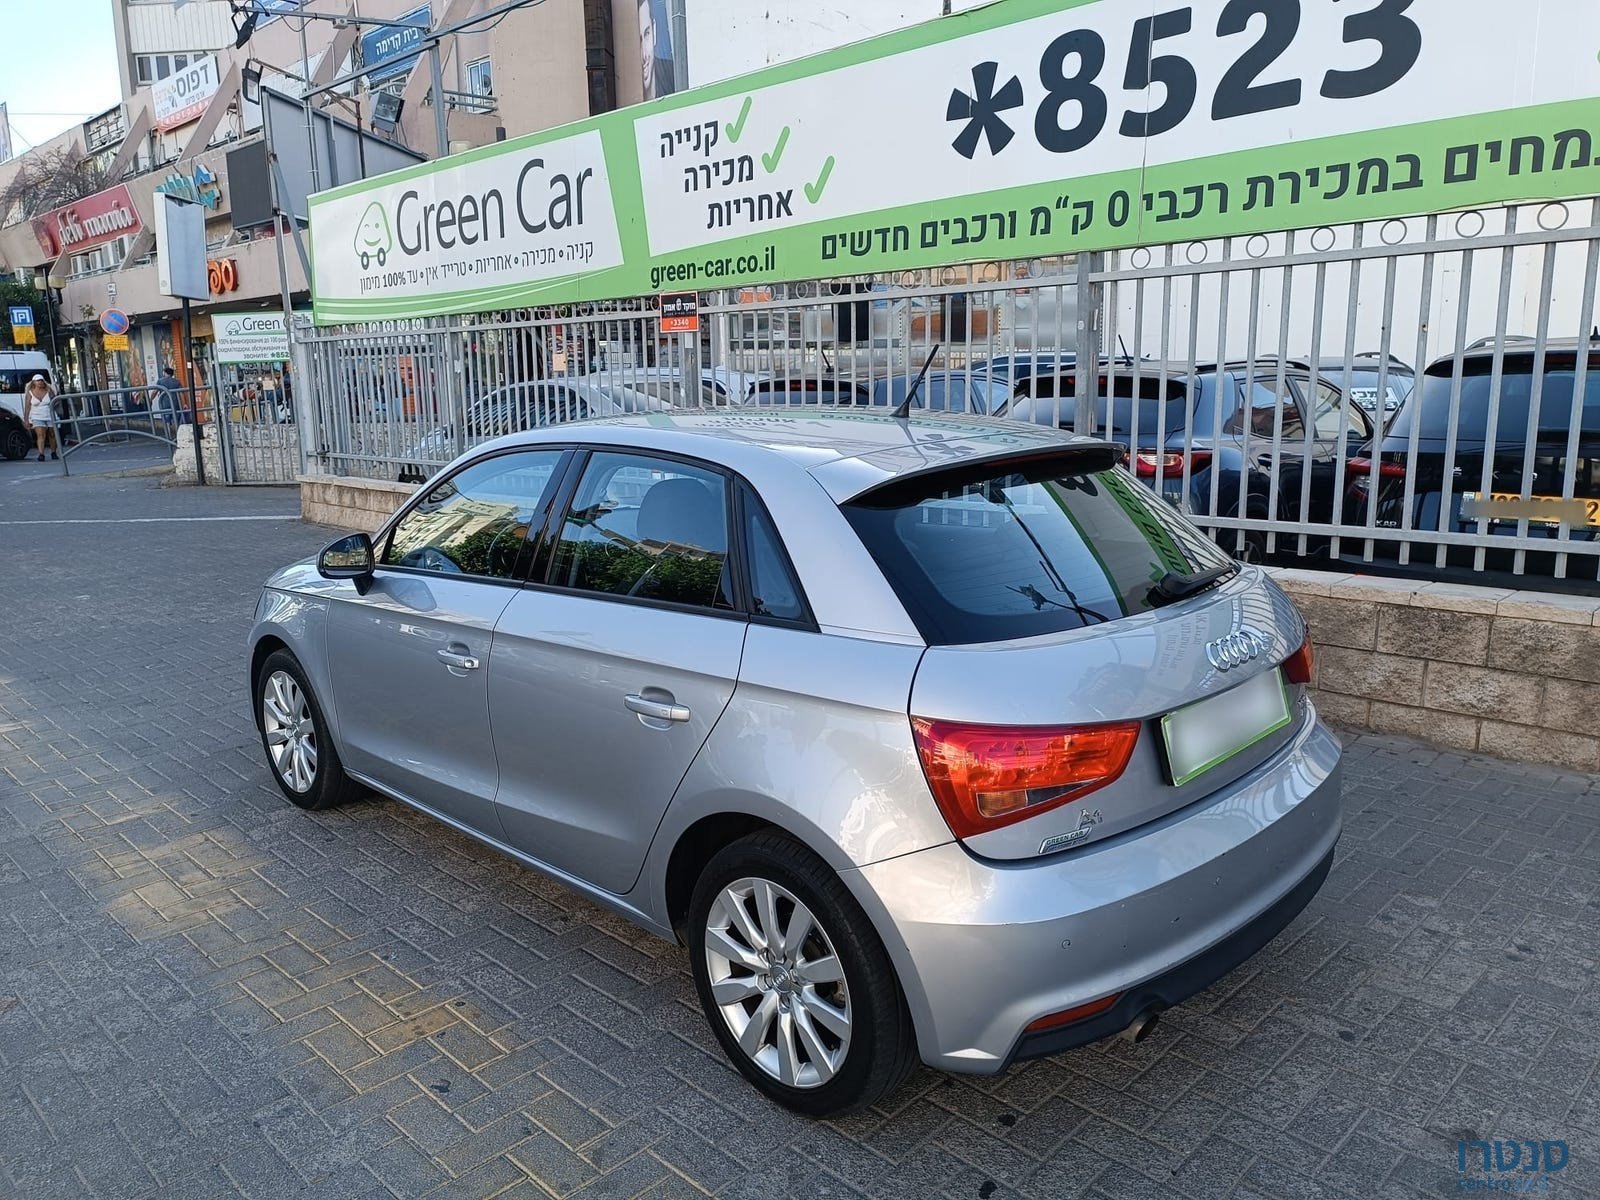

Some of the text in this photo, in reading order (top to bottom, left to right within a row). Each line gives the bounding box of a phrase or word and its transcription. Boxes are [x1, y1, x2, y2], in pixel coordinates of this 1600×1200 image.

[403, 28, 419, 43] בית
[176, 64, 208, 97] דפוס
[660, 120, 719, 158] קנייה
[1443, 128, 1600, 185] מחים
[684, 154, 754, 193] מכירה
[1242, 153, 1424, 211] במכירת
[396, 158, 593, 256] Green Car
[707, 189, 794, 229] אחריות
[1107, 189, 1130, 228] 0
[1142, 181, 1229, 222] רכבי
[59, 209, 83, 245] deli
[821, 225, 910, 260] חדשים
[920, 210, 1017, 249] ורכבים
[360, 241, 593, 295] קניה מכירה אחריות טרייד אין עד 100% מימון
[650, 246, 775, 288] green-car.co.il
[242, 317, 280, 331] Green
[1046, 834, 1070, 846] GREEN
[1070, 830, 1084, 839] CAR
